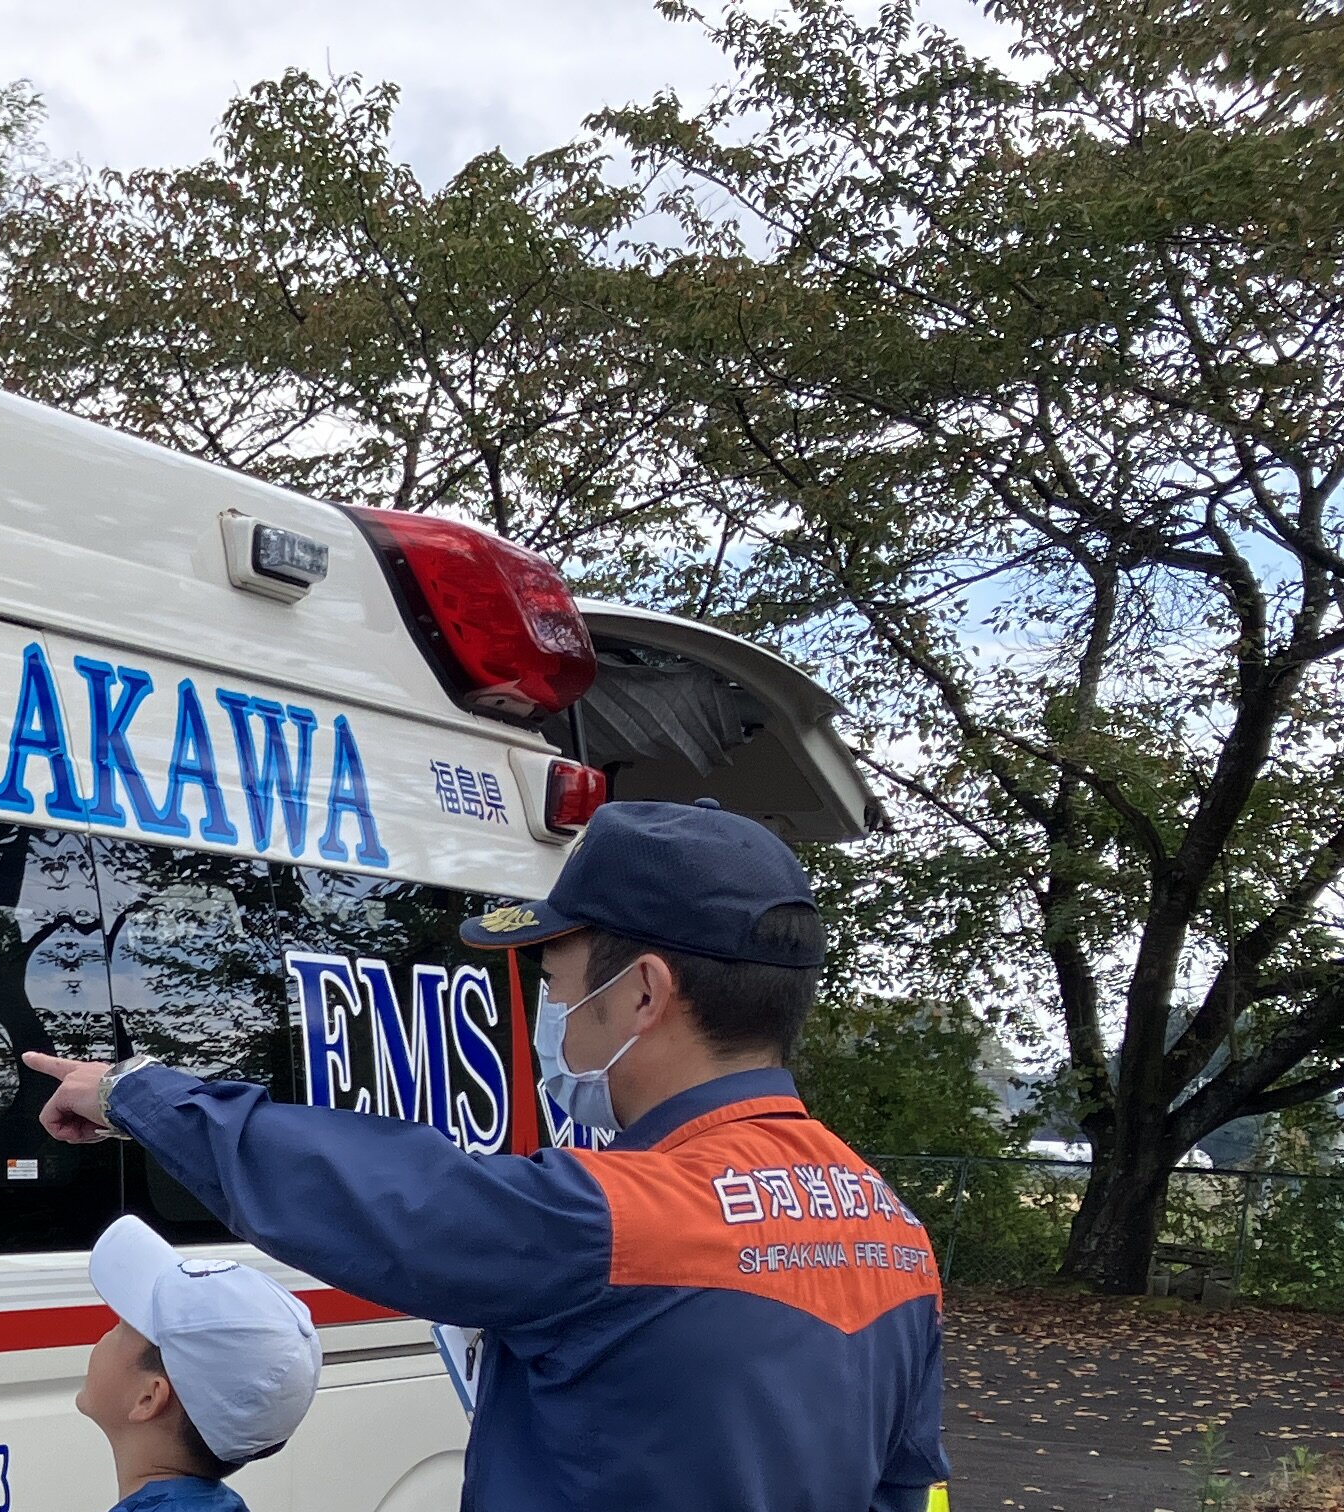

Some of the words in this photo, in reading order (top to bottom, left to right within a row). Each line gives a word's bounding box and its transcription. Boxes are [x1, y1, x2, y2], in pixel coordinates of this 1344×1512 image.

[429, 758, 510, 825] 福島県
[285, 950, 510, 1156] EMS
[738, 1242, 849, 1274] SHIRAKAWA
[854, 1243, 889, 1269] FIRE
[893, 1245, 934, 1278] DEPT.
